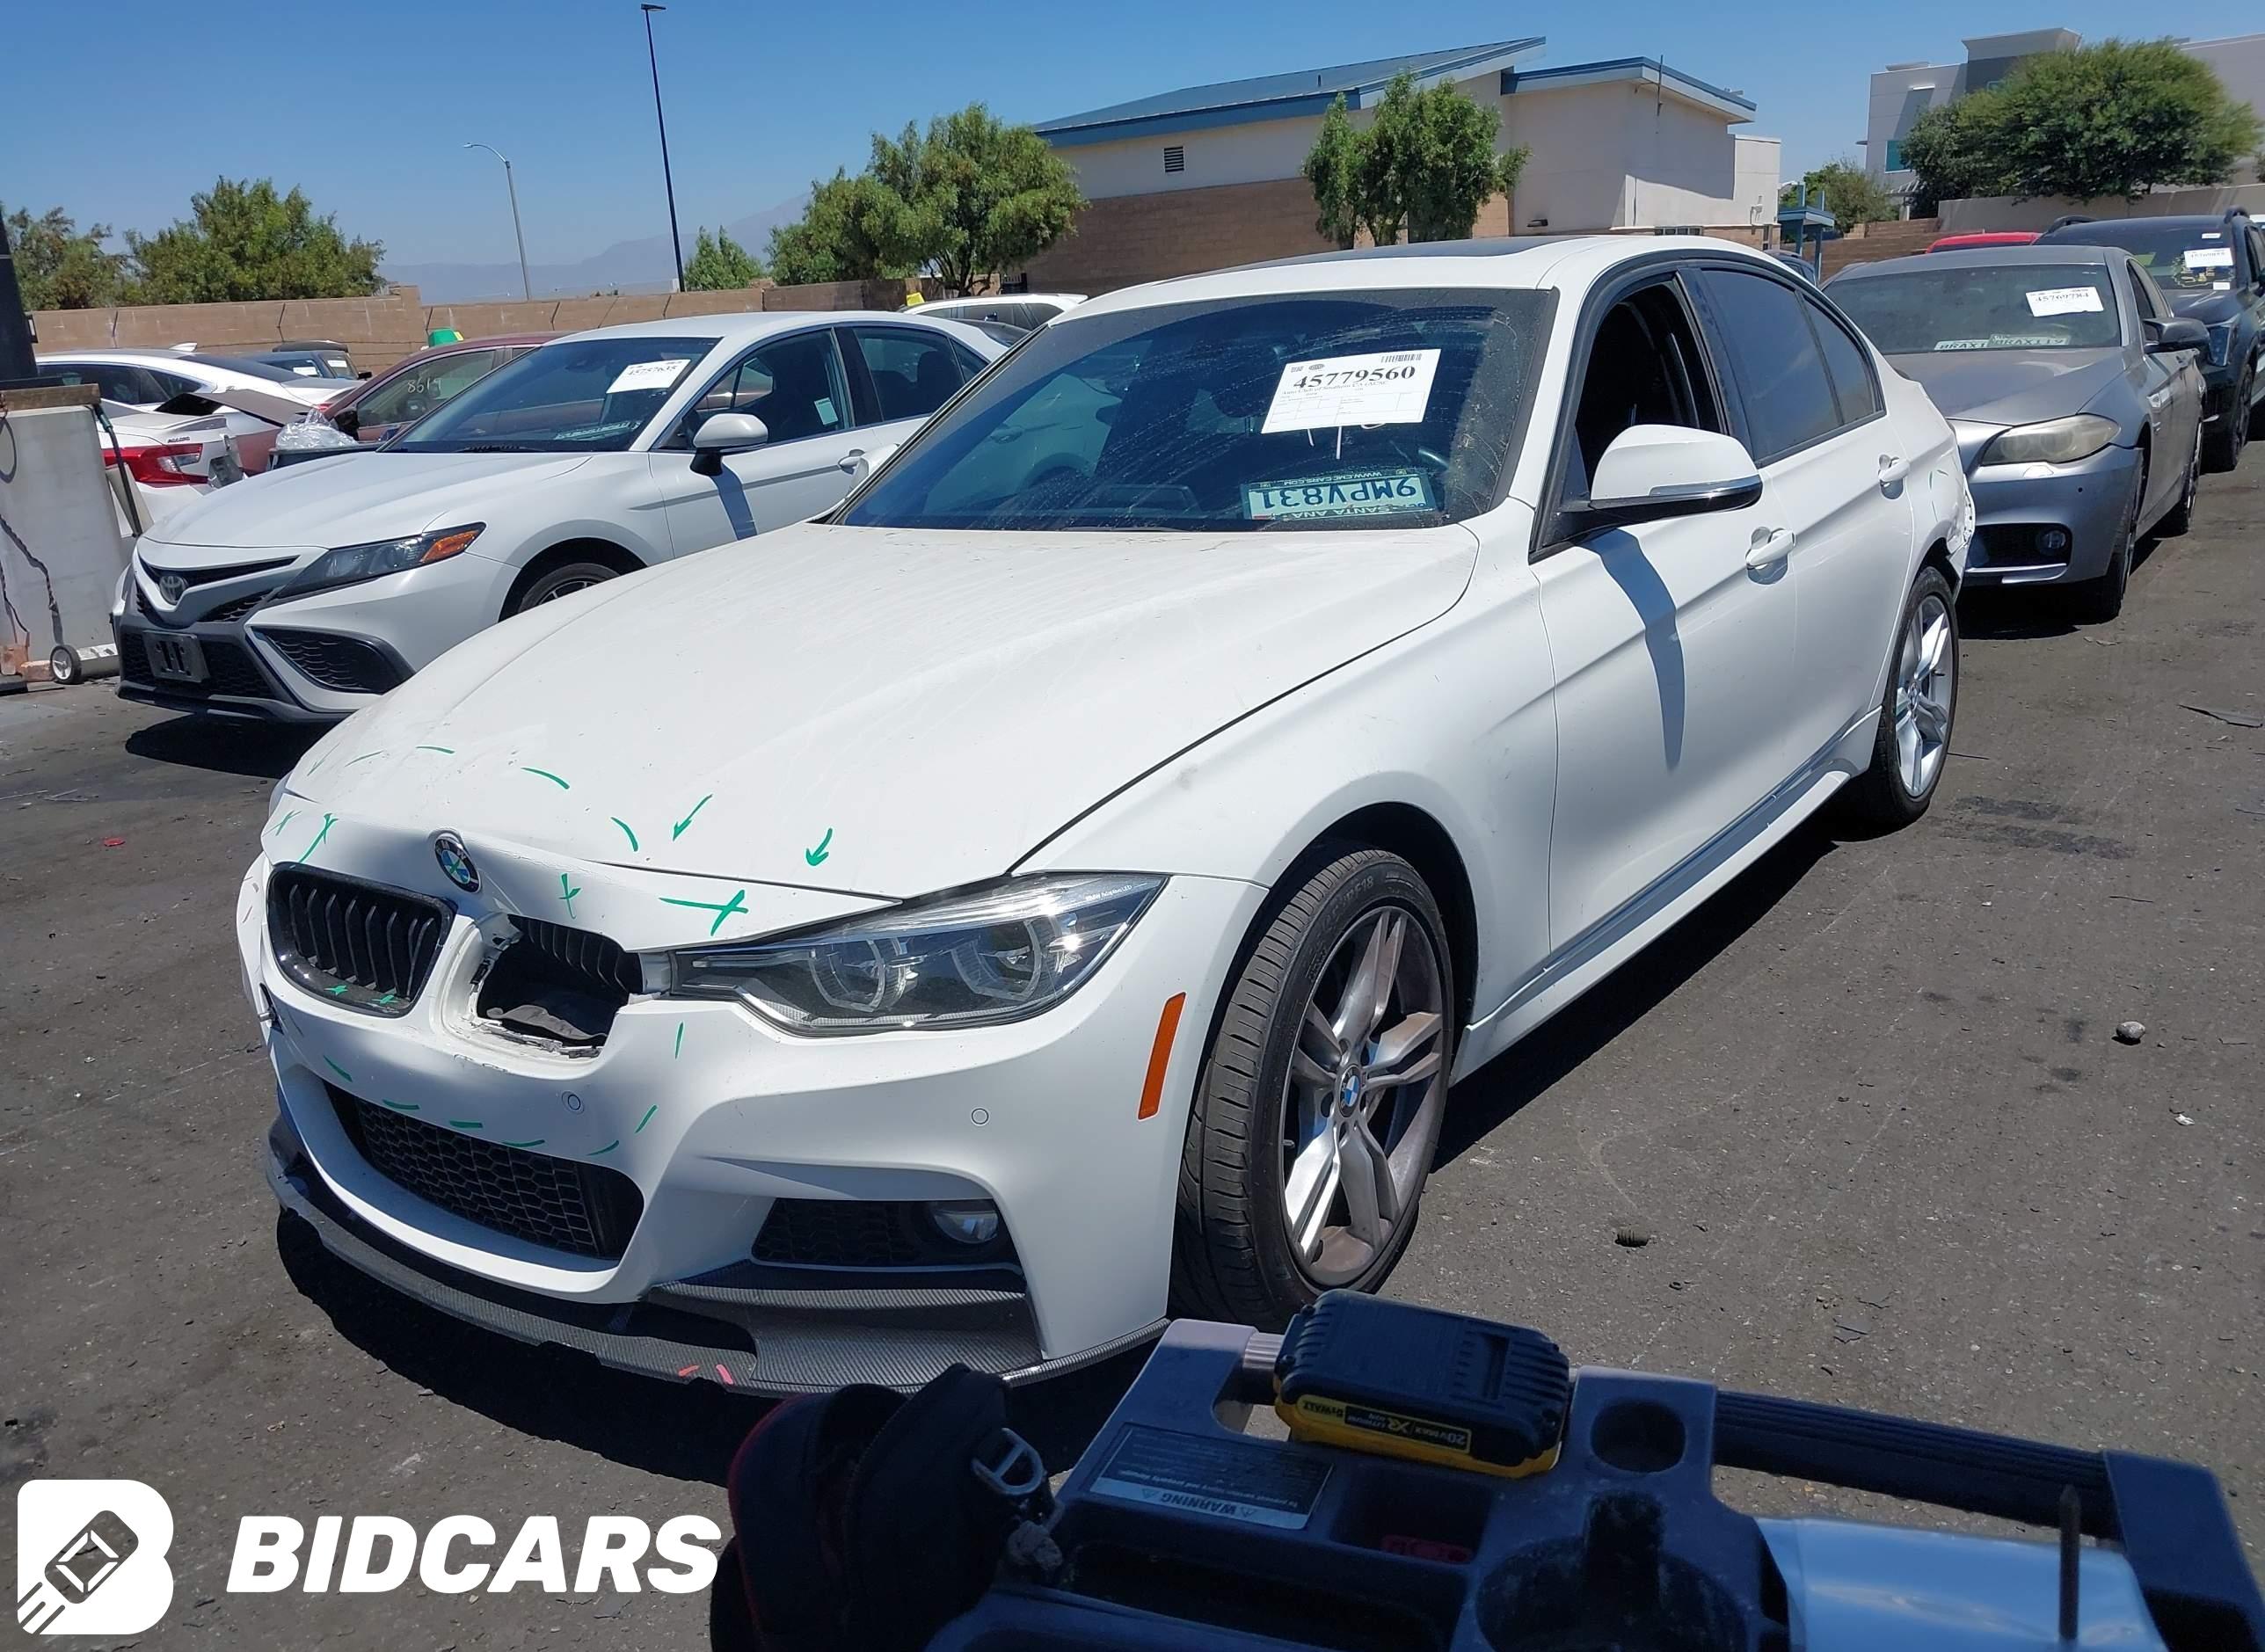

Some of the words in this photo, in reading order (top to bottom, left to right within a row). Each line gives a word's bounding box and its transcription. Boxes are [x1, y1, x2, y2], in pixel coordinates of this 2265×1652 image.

[1293, 366, 1416, 389] 45779560
[1262, 477, 1417, 509] 9MPV831
[1292, 510, 1326, 519] ANA
[1332, 506, 1391, 517] SANTA
[1387, 1416, 1410, 1434] XR
[1160, 1492, 1237, 1516] WARNING
